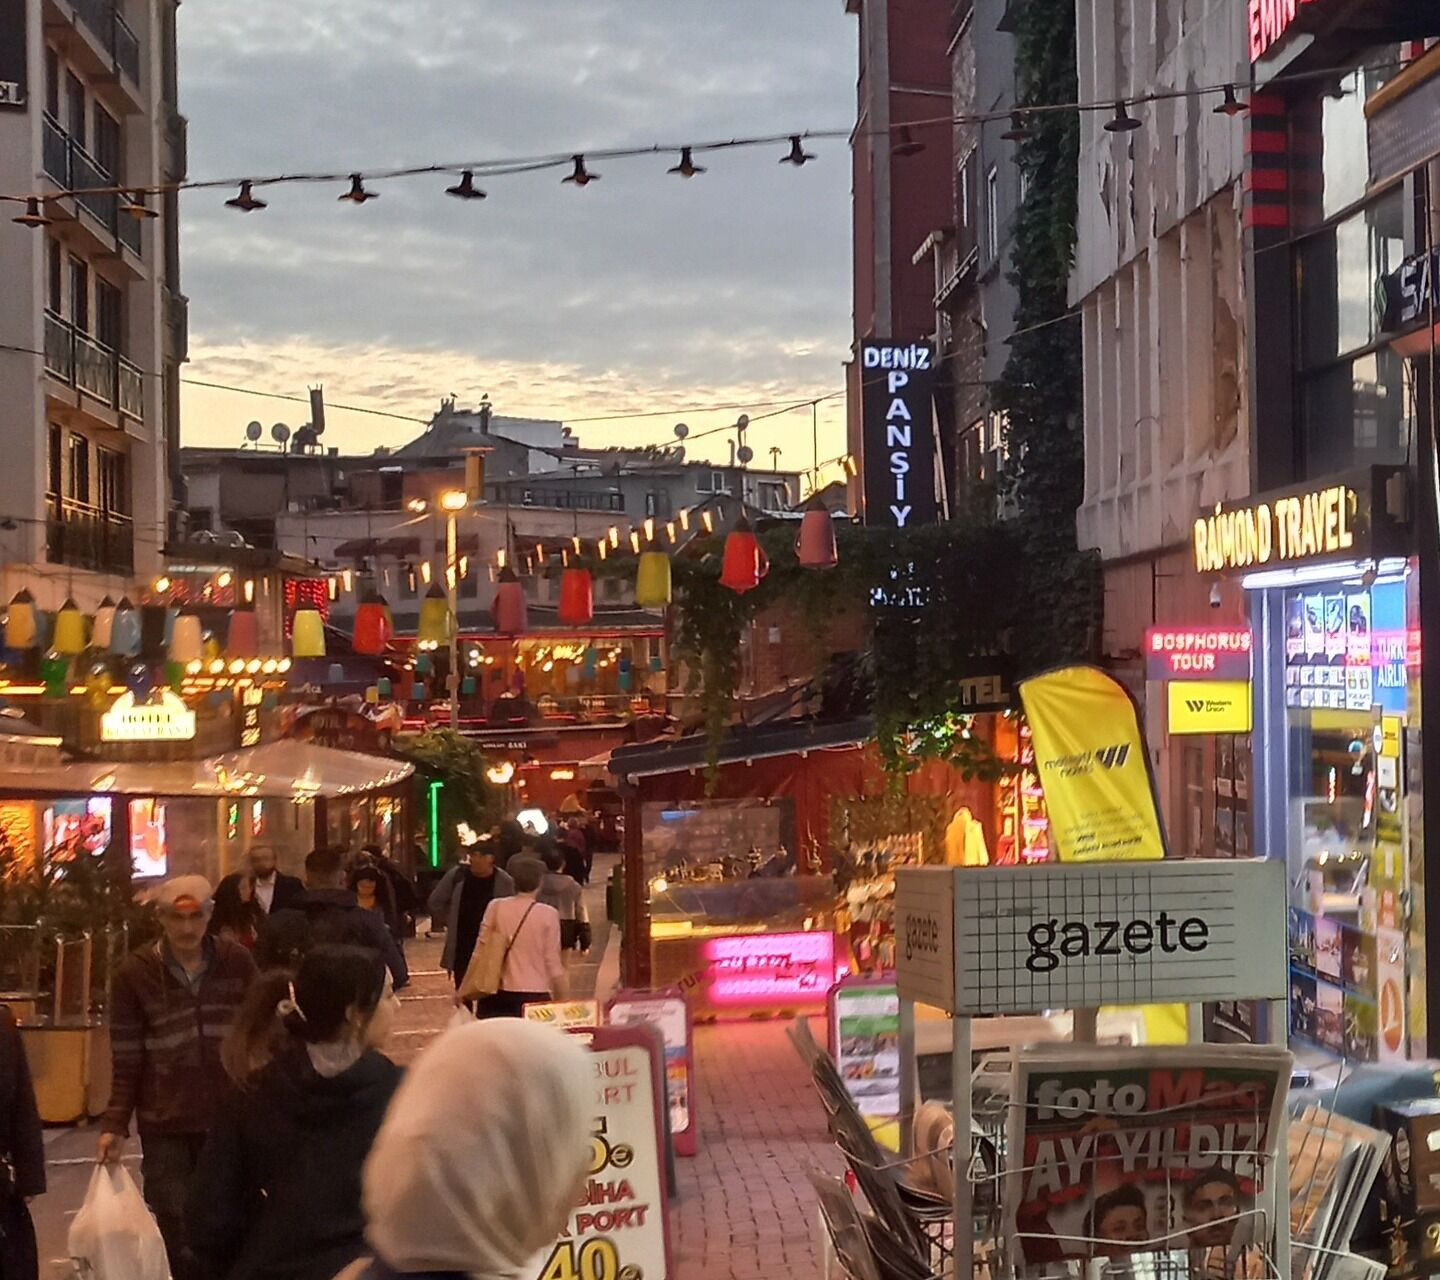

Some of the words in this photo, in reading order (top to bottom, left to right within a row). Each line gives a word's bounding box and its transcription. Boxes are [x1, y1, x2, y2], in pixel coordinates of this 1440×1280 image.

[863, 343, 930, 370] DENİZ
[1274, 484, 1353, 560] TRAVEL
[1151, 631, 1251, 652] BOSPHORUS
[1169, 652, 1216, 671] TOUR
[905, 913, 939, 961] gazete
[1025, 911, 1210, 973] gazete
[1027, 1134, 1095, 1201] AY
[1113, 1121, 1267, 1179] YILDIZ
[575, 1203, 649, 1236] PORT
